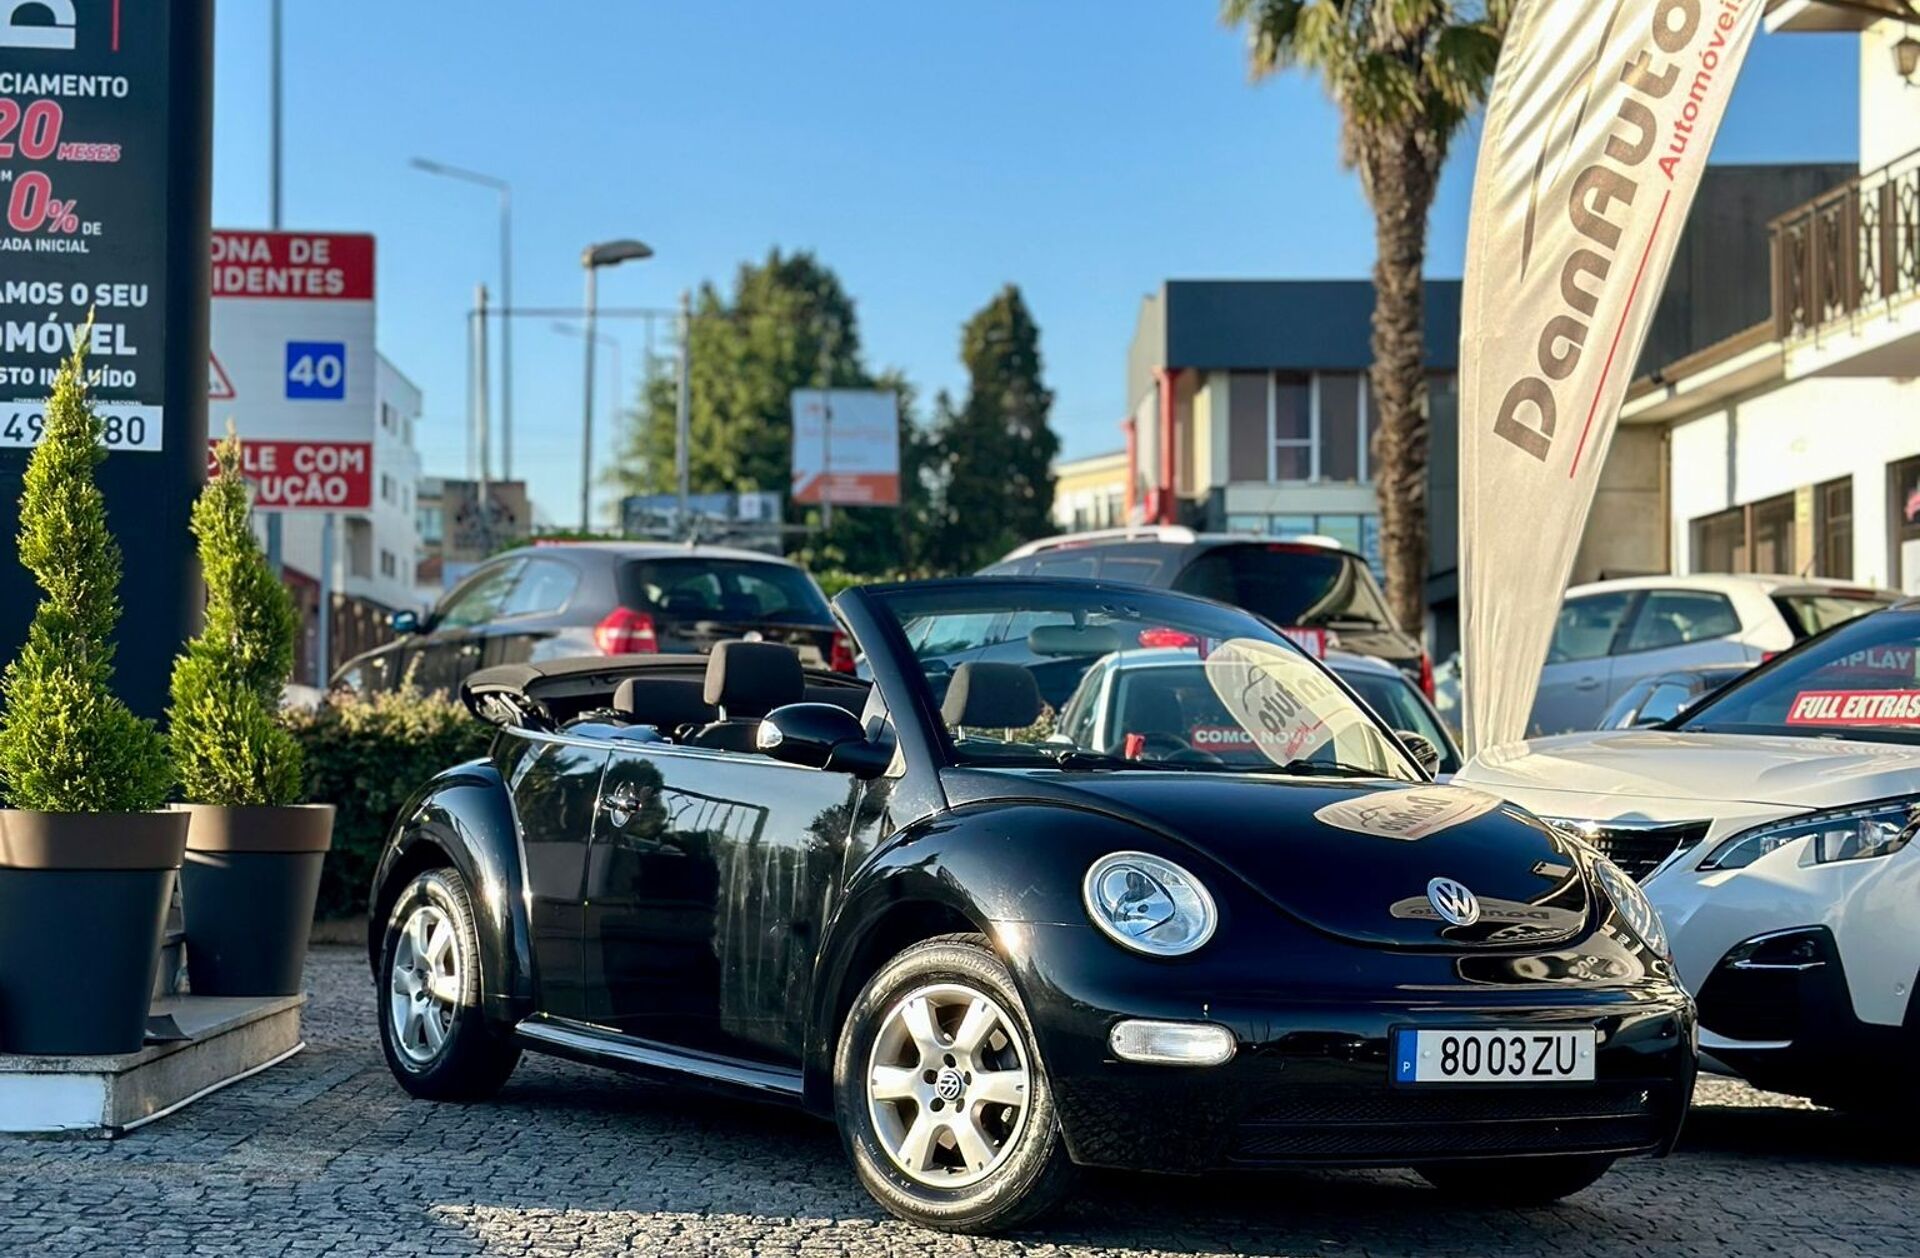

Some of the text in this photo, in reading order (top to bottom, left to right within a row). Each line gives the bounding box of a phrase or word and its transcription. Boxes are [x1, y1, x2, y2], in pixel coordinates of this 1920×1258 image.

[0, 72, 128, 97] CIAMENTO
[1658, 0, 1742, 181] Automóvei
[57, 143, 121, 162] MESES
[82, 221, 102, 236] DE
[0, 237, 90, 253] ADA INICIAL
[290, 239, 330, 264] DE
[213, 266, 345, 295] IDENTES
[70, 283, 88, 306] O
[95, 283, 148, 307] SEU
[0, 312, 137, 355] MÓVEL
[289, 354, 342, 388] 40
[293, 446, 364, 473] COM
[1792, 695, 1920, 720] FULL EXTRAS
[1195, 729, 1253, 744] COMO
[1402, 1062, 1411, 1073] P
